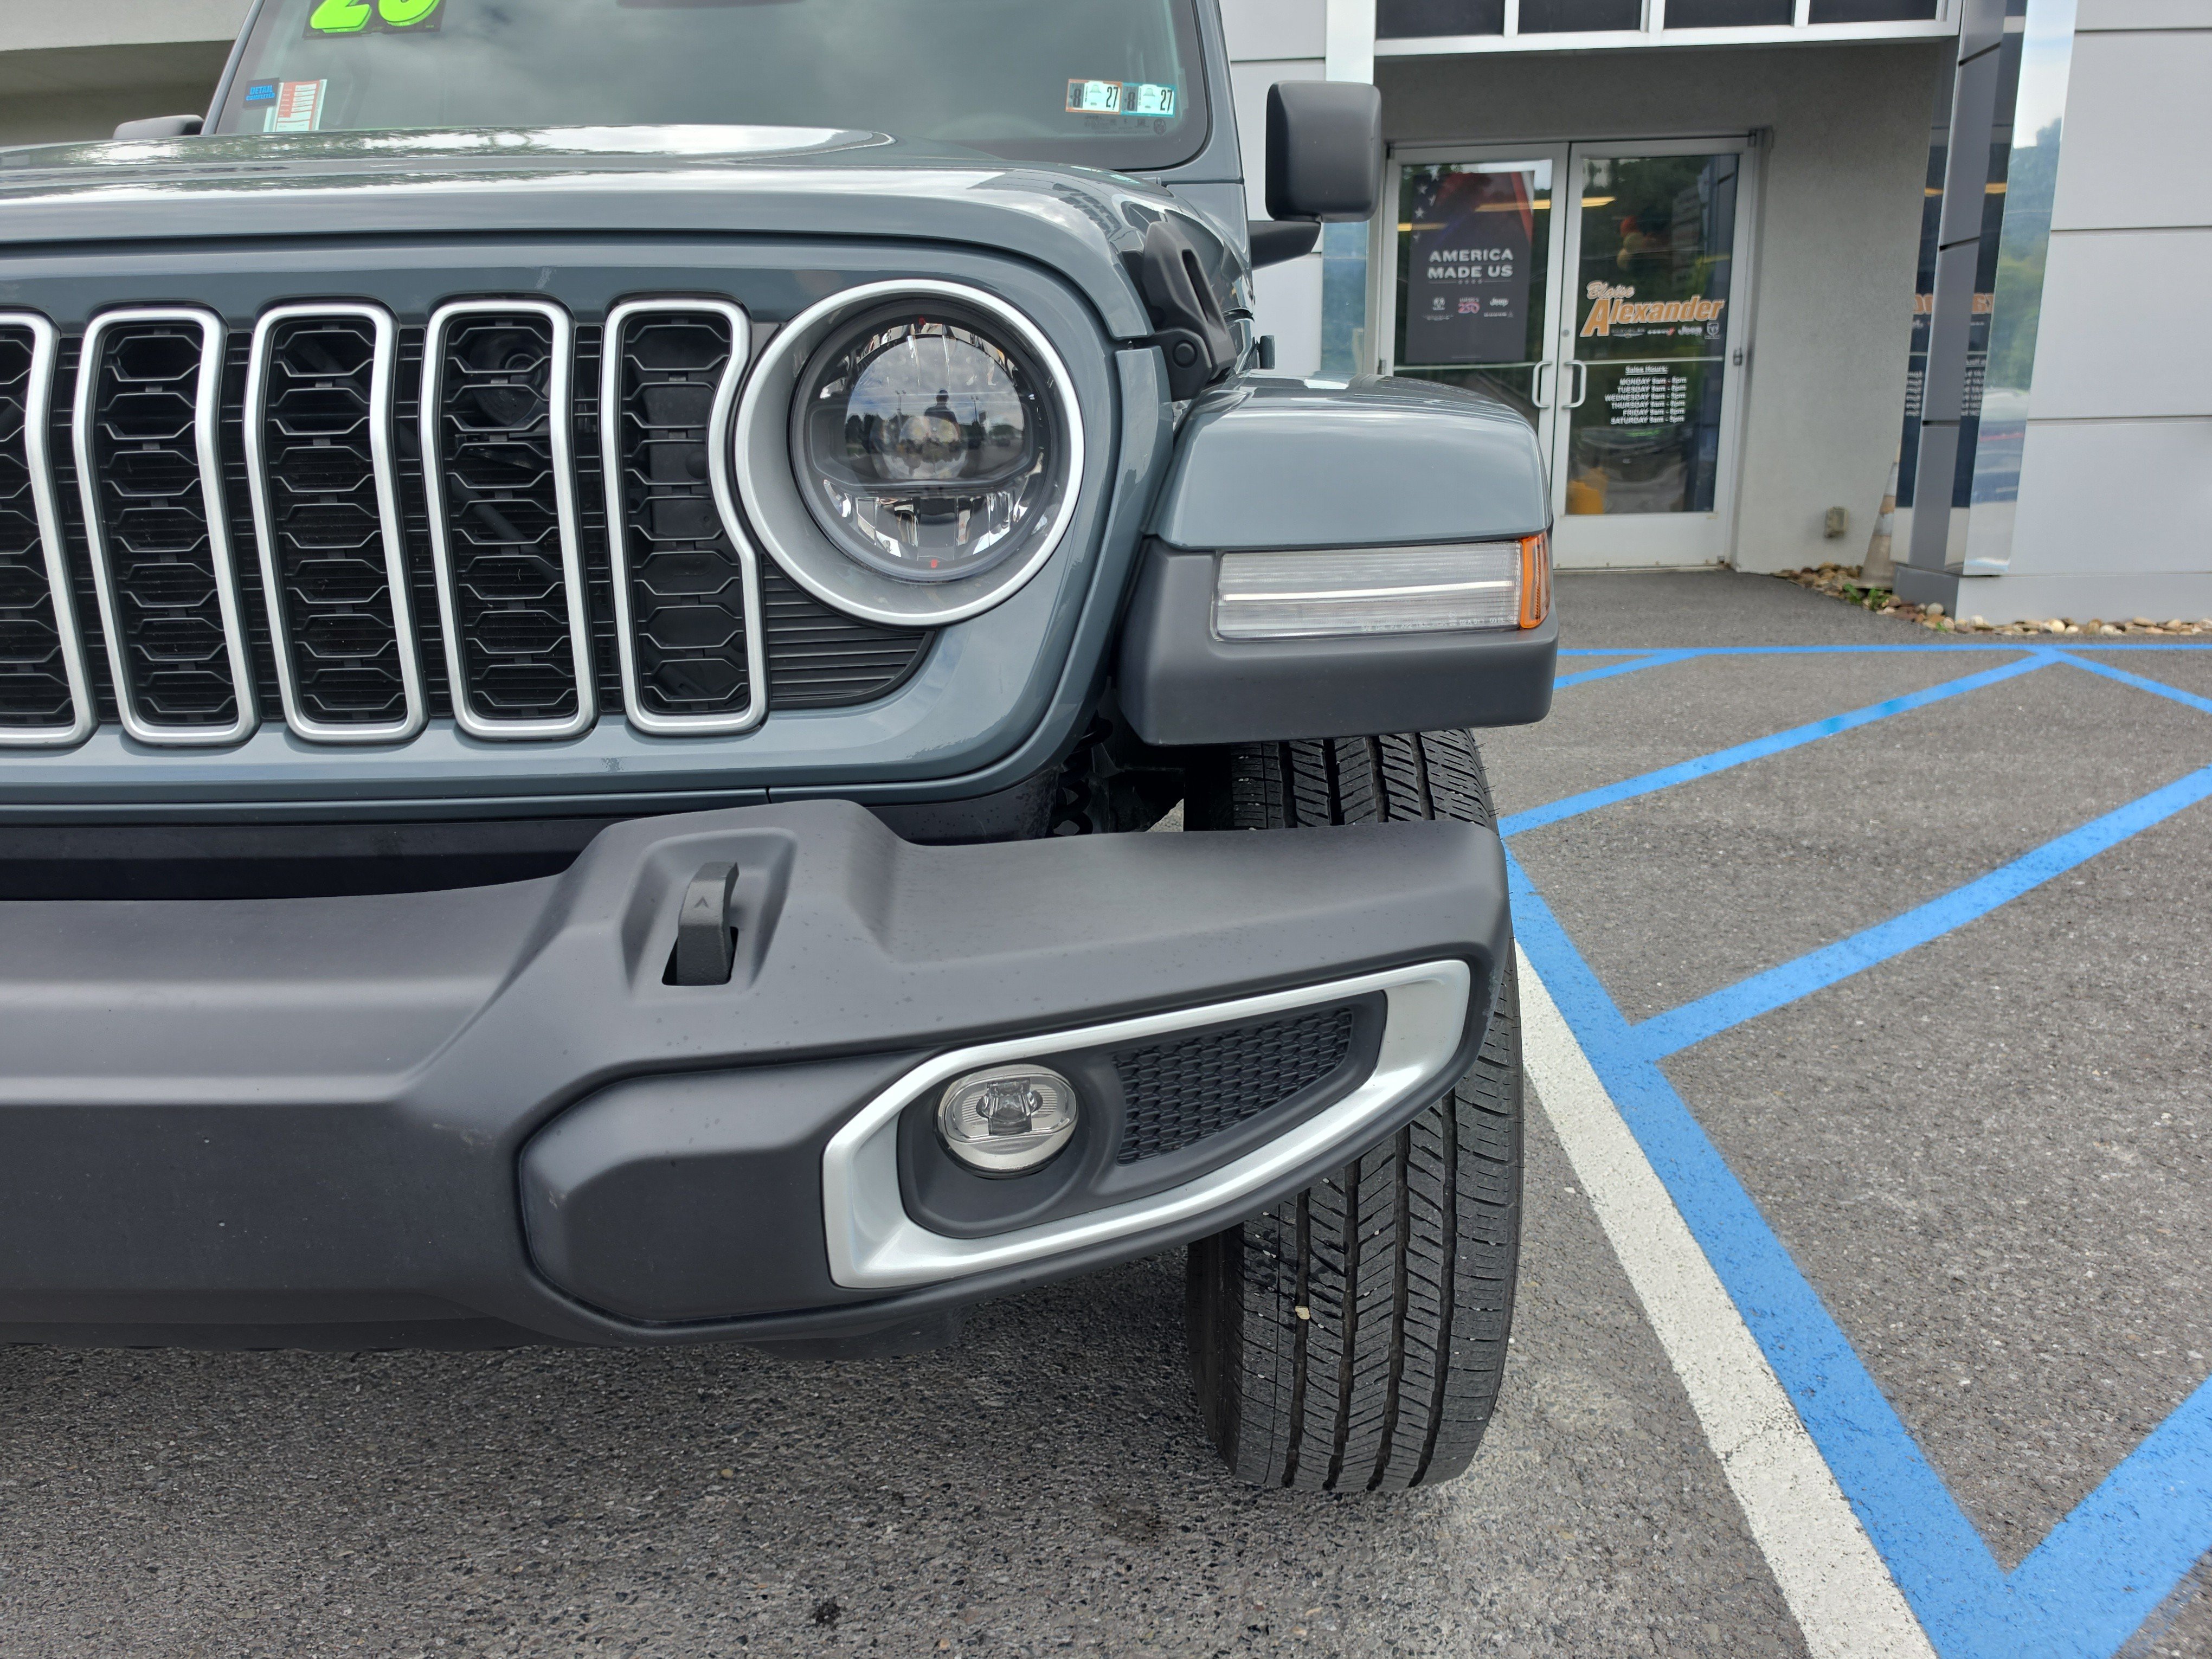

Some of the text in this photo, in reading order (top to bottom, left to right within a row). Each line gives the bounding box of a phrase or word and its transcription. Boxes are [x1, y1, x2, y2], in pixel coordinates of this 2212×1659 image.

[250, 85, 273, 95] DETAIL
[1105, 86, 1119, 110] 27
[1160, 89, 1173, 113] 27
[1429, 248, 1514, 262] AMERICA
[1427, 265, 1513, 279] MADE US
[1580, 294, 1726, 337] Alexander
[1625, 365, 1644, 374] Sales
[1619, 377, 1651, 385] MONDAY
[1617, 385, 1650, 393] TUESDAY
[1604, 393, 1650, 402] WEDNESDAY
[1611, 400, 1650, 409] THURSDAY
[1623, 408, 1649, 416] FRIDAY
[1610, 415, 1649, 425] SATURDAY
